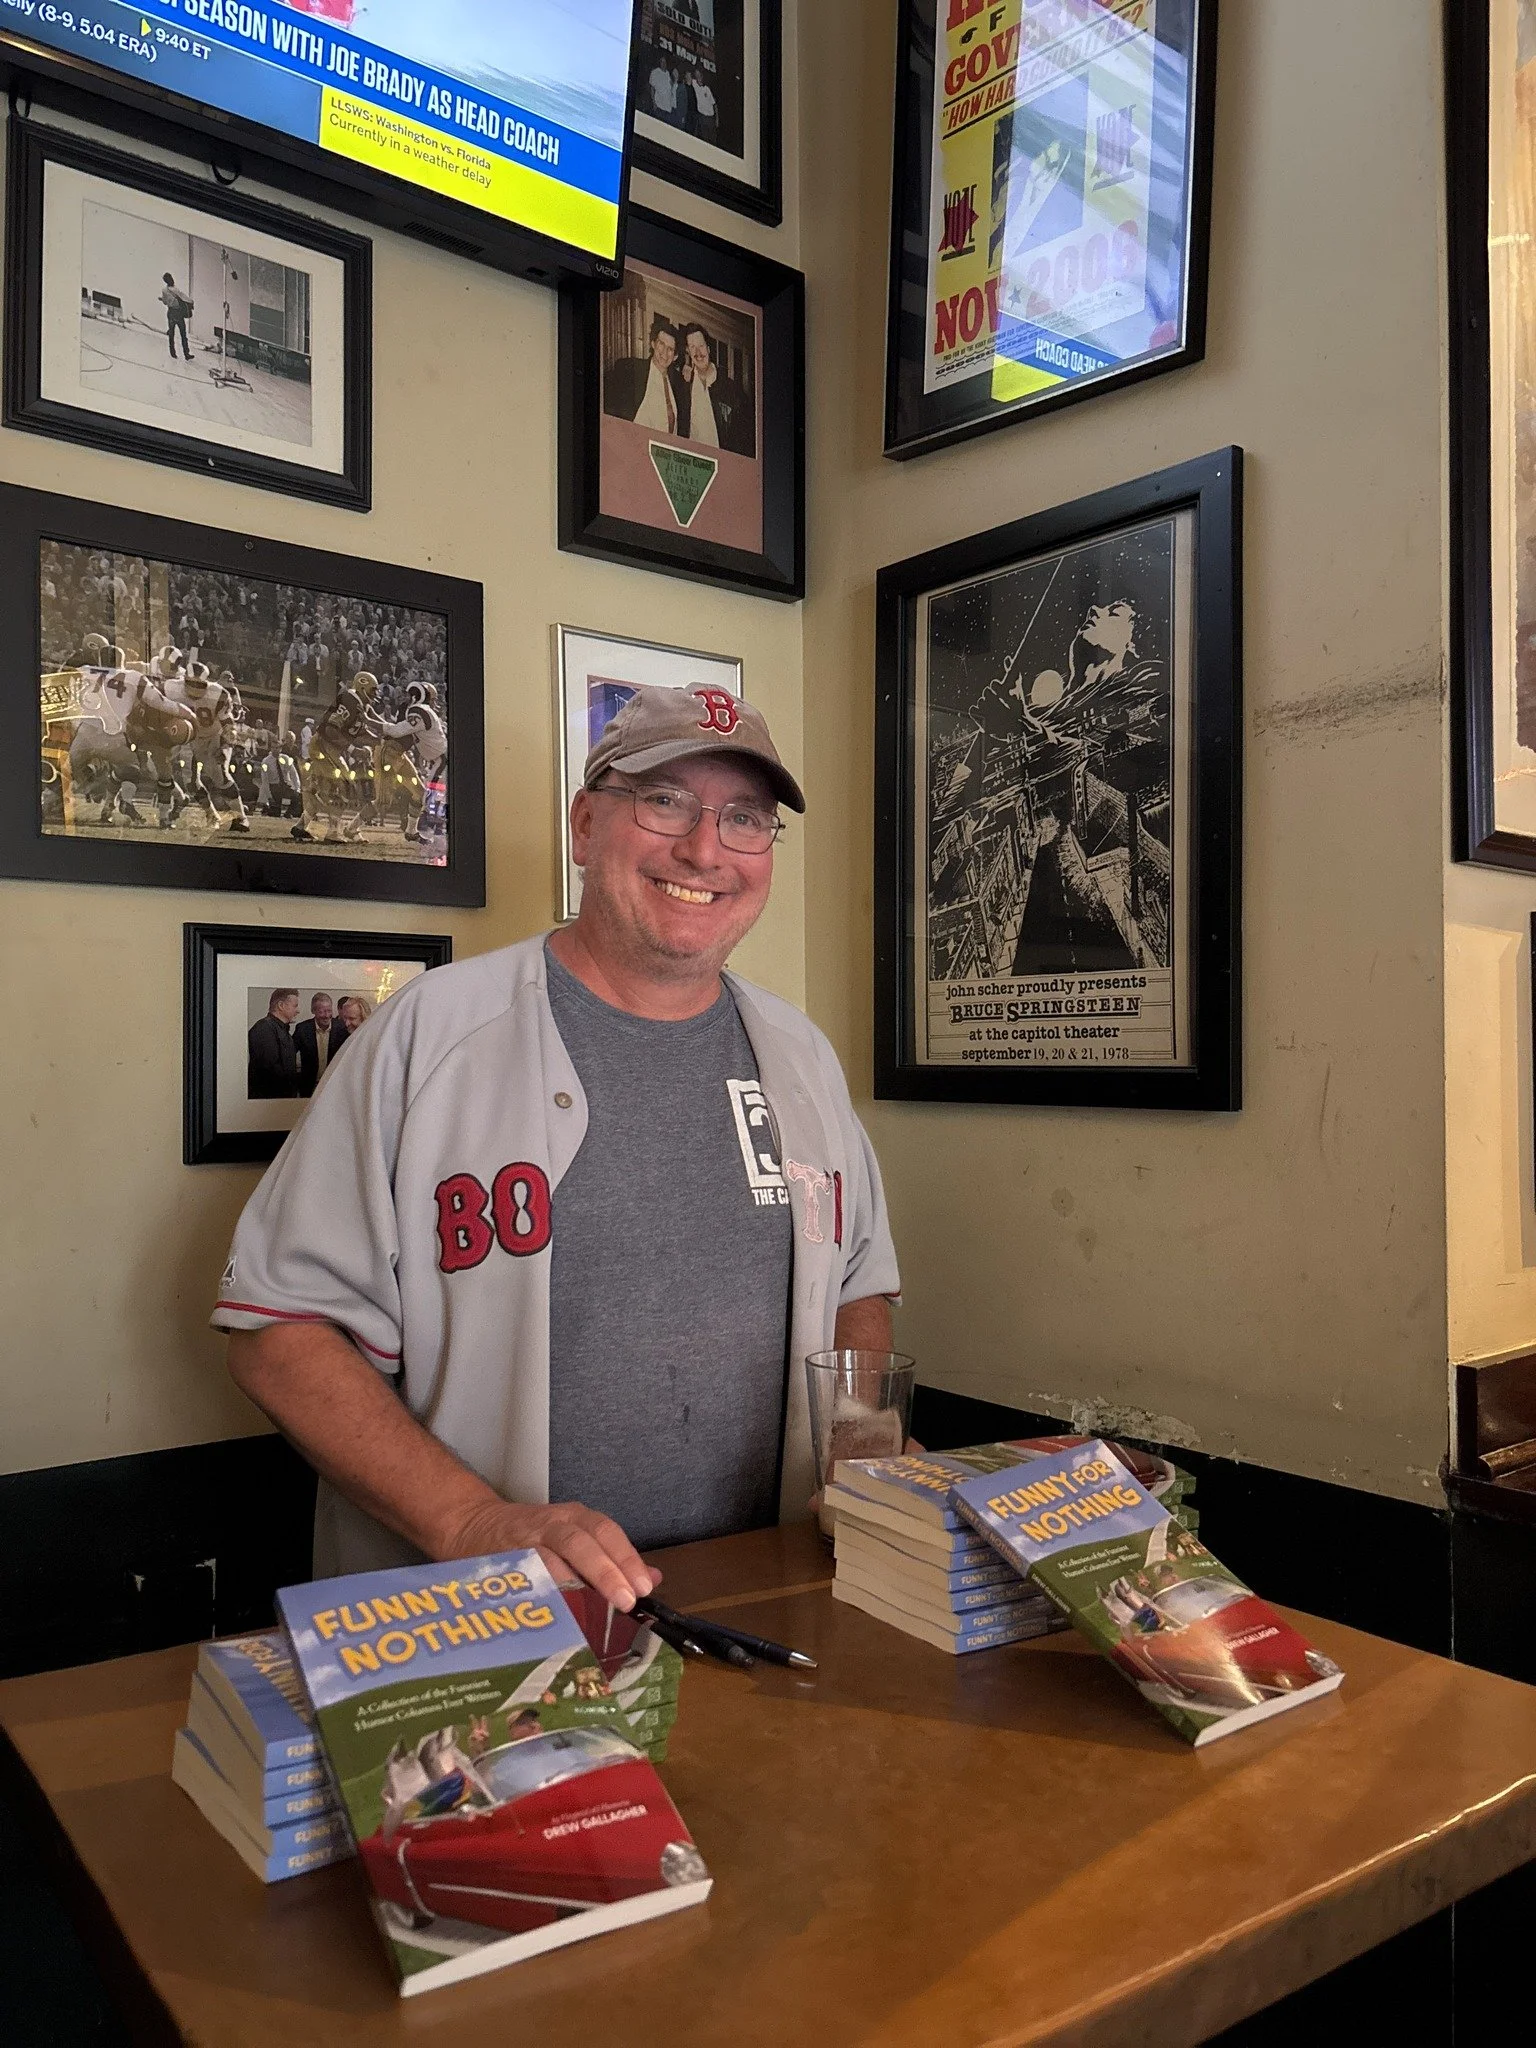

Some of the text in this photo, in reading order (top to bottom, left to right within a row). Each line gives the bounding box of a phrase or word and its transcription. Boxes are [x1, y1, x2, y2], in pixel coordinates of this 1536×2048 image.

[2, 0, 158, 63] elly (8-9, 5.04 ERA)
[155, 28, 212, 61] 9:40 ET
[184, 0, 560, 166] SEASON WITH JOE BRADY AS HEAD COACH
[329, 114, 492, 188] Currently in a weather delay
[331, 96, 491, 170] LLSWS: Washington vs. Florida
[595, 262, 619, 279] VIZIO
[691, 689, 744, 736] B
[945, 975, 1147, 1000] john scher proudly presents
[950, 997, 1142, 1024] BRUCE SPRINGSTEEN
[961, 1047, 1129, 1063] september 19, 20 & 21, 1978
[969, 1025, 1120, 1043] at the capitol theater
[751, 1188, 776, 1206] THE
[986, 1459, 1114, 1520] FUNNY FOR
[1019, 1484, 1143, 1543] NOTHING
[312, 1570, 532, 1642] FUNNY FOR
[340, 1600, 555, 1676] NOTHING
[543, 1820, 580, 1840] DREW
[581, 1804, 648, 1829] GALLAGHER
